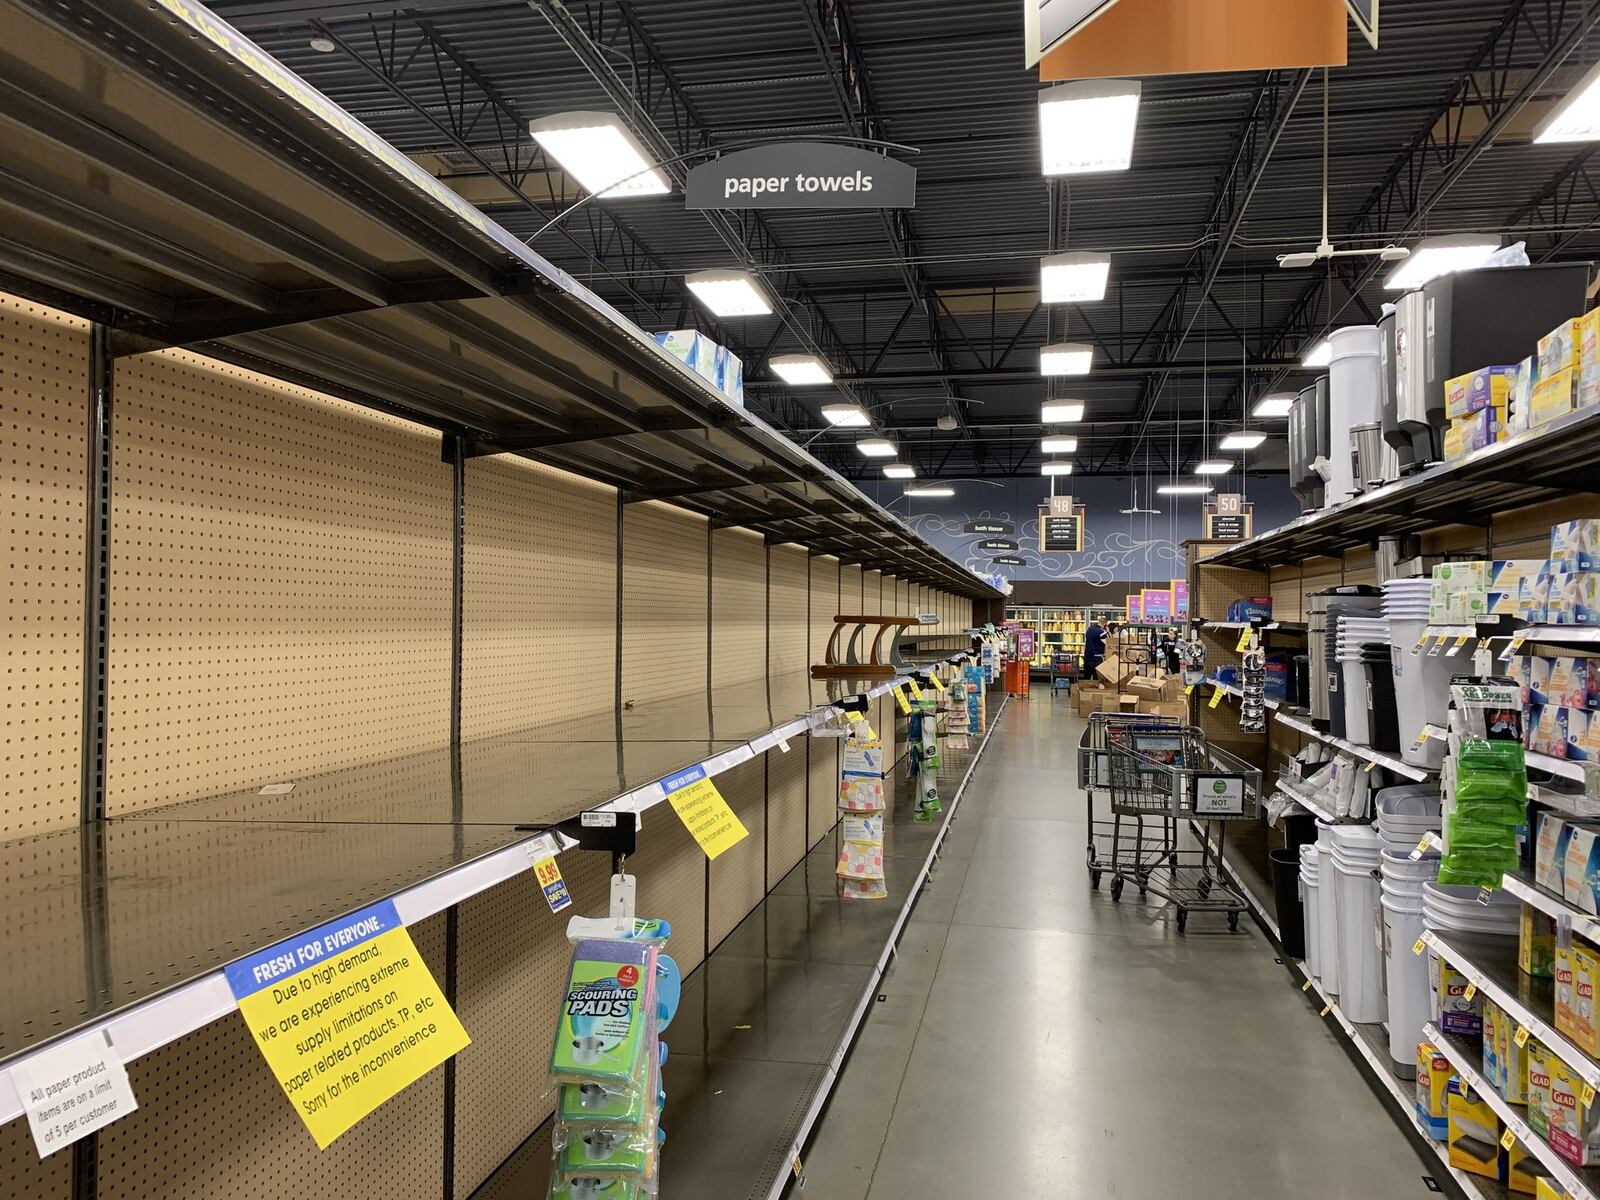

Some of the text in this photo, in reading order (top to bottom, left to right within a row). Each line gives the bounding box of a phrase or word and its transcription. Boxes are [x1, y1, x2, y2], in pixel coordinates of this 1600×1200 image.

[724, 170, 873, 198] paper towels
[1054, 499, 1069, 513] 48
[1221, 497, 1237, 511] 50
[252, 952, 297, 984] FRESH
[296, 941, 324, 964] FOR
[626, 967, 633, 975] 4
[272, 943, 383, 1005] Due to high demand,
[1558, 970, 1572, 980] GLAD
[259, 957, 410, 1043] we are experiencing extreme
[569, 989, 637, 1001] SCOURING
[1578, 983, 1592, 996] GLAD
[569, 1000, 629, 1017] PADS
[296, 990, 399, 1056] supply limitations on
[284, 996, 434, 1096] paper related products. TP, etc
[302, 1022, 438, 1115] Sorry for the inconvenience
[30, 1061, 107, 1103] All paper product
[1418, 1074, 1430, 1086] GLAD
[1531, 1073, 1549, 1088] GLAD
[37, 1079, 113, 1123] items are on a limit
[1554, 1091, 1575, 1107] GLAD
[44, 1099, 118, 1143] of 5 per customer
